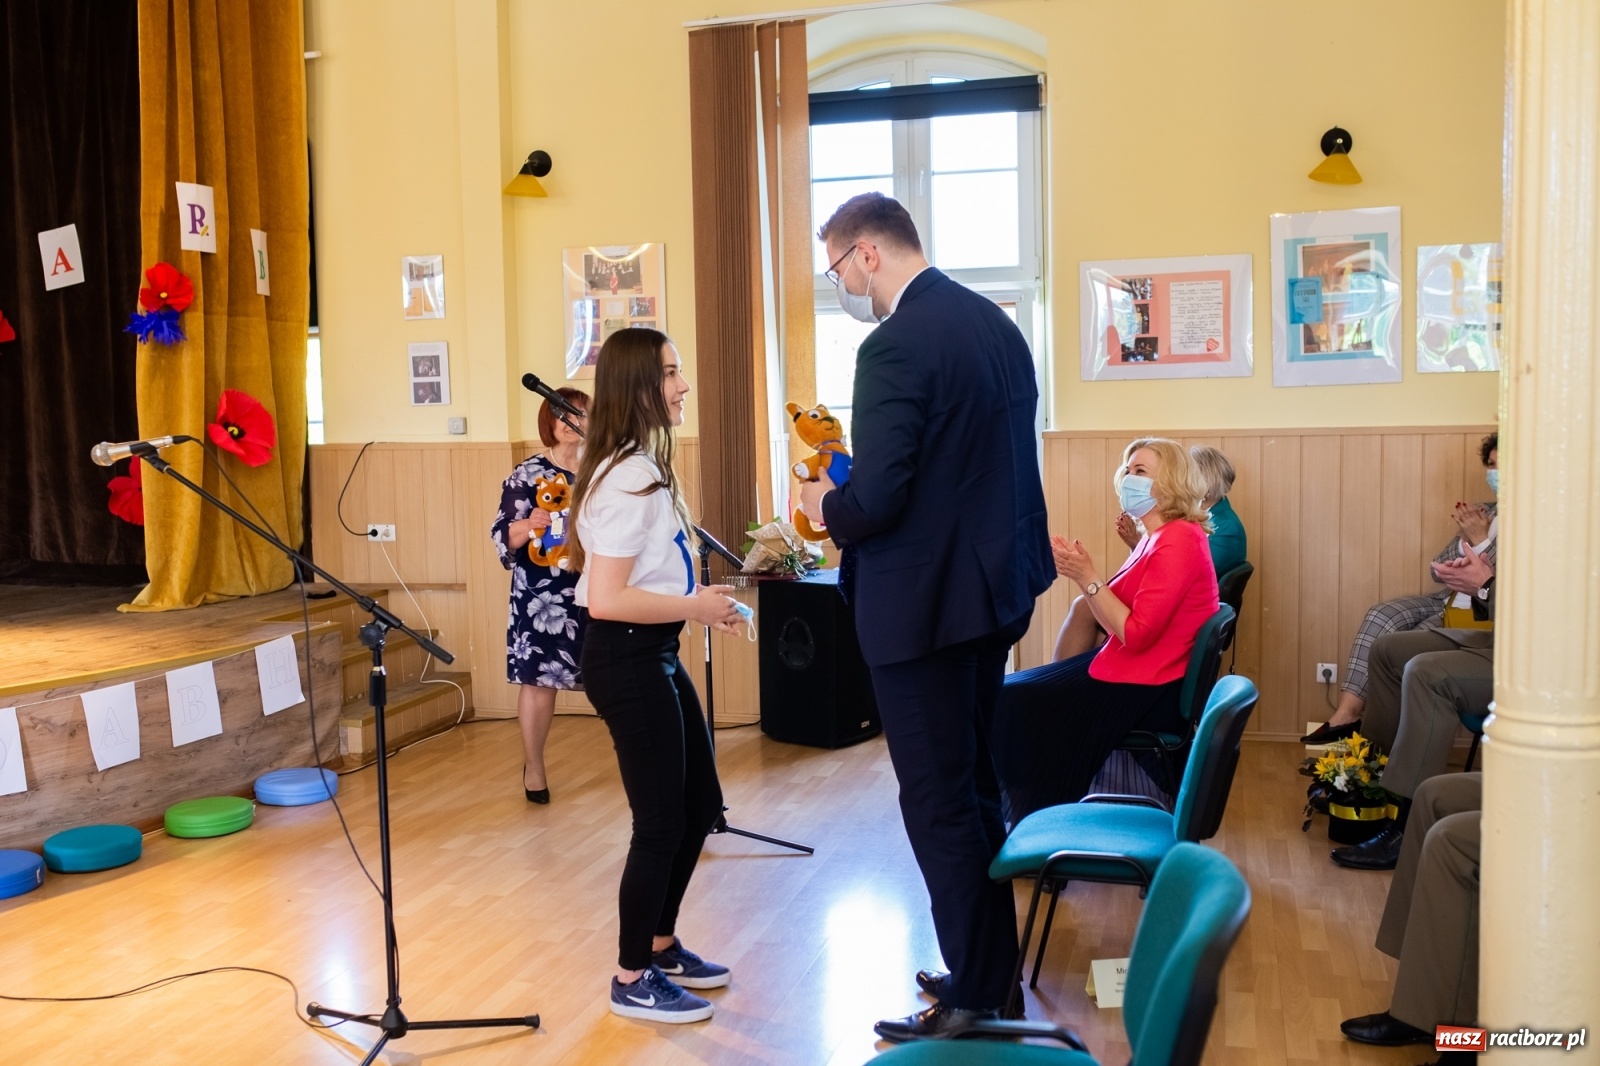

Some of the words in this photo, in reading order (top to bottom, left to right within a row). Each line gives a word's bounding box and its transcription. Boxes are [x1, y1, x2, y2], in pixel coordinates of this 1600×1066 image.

[50, 247, 74, 276] A
[265, 647, 297, 690] H
[177, 684, 207, 727] B
[97, 706, 130, 751] A
